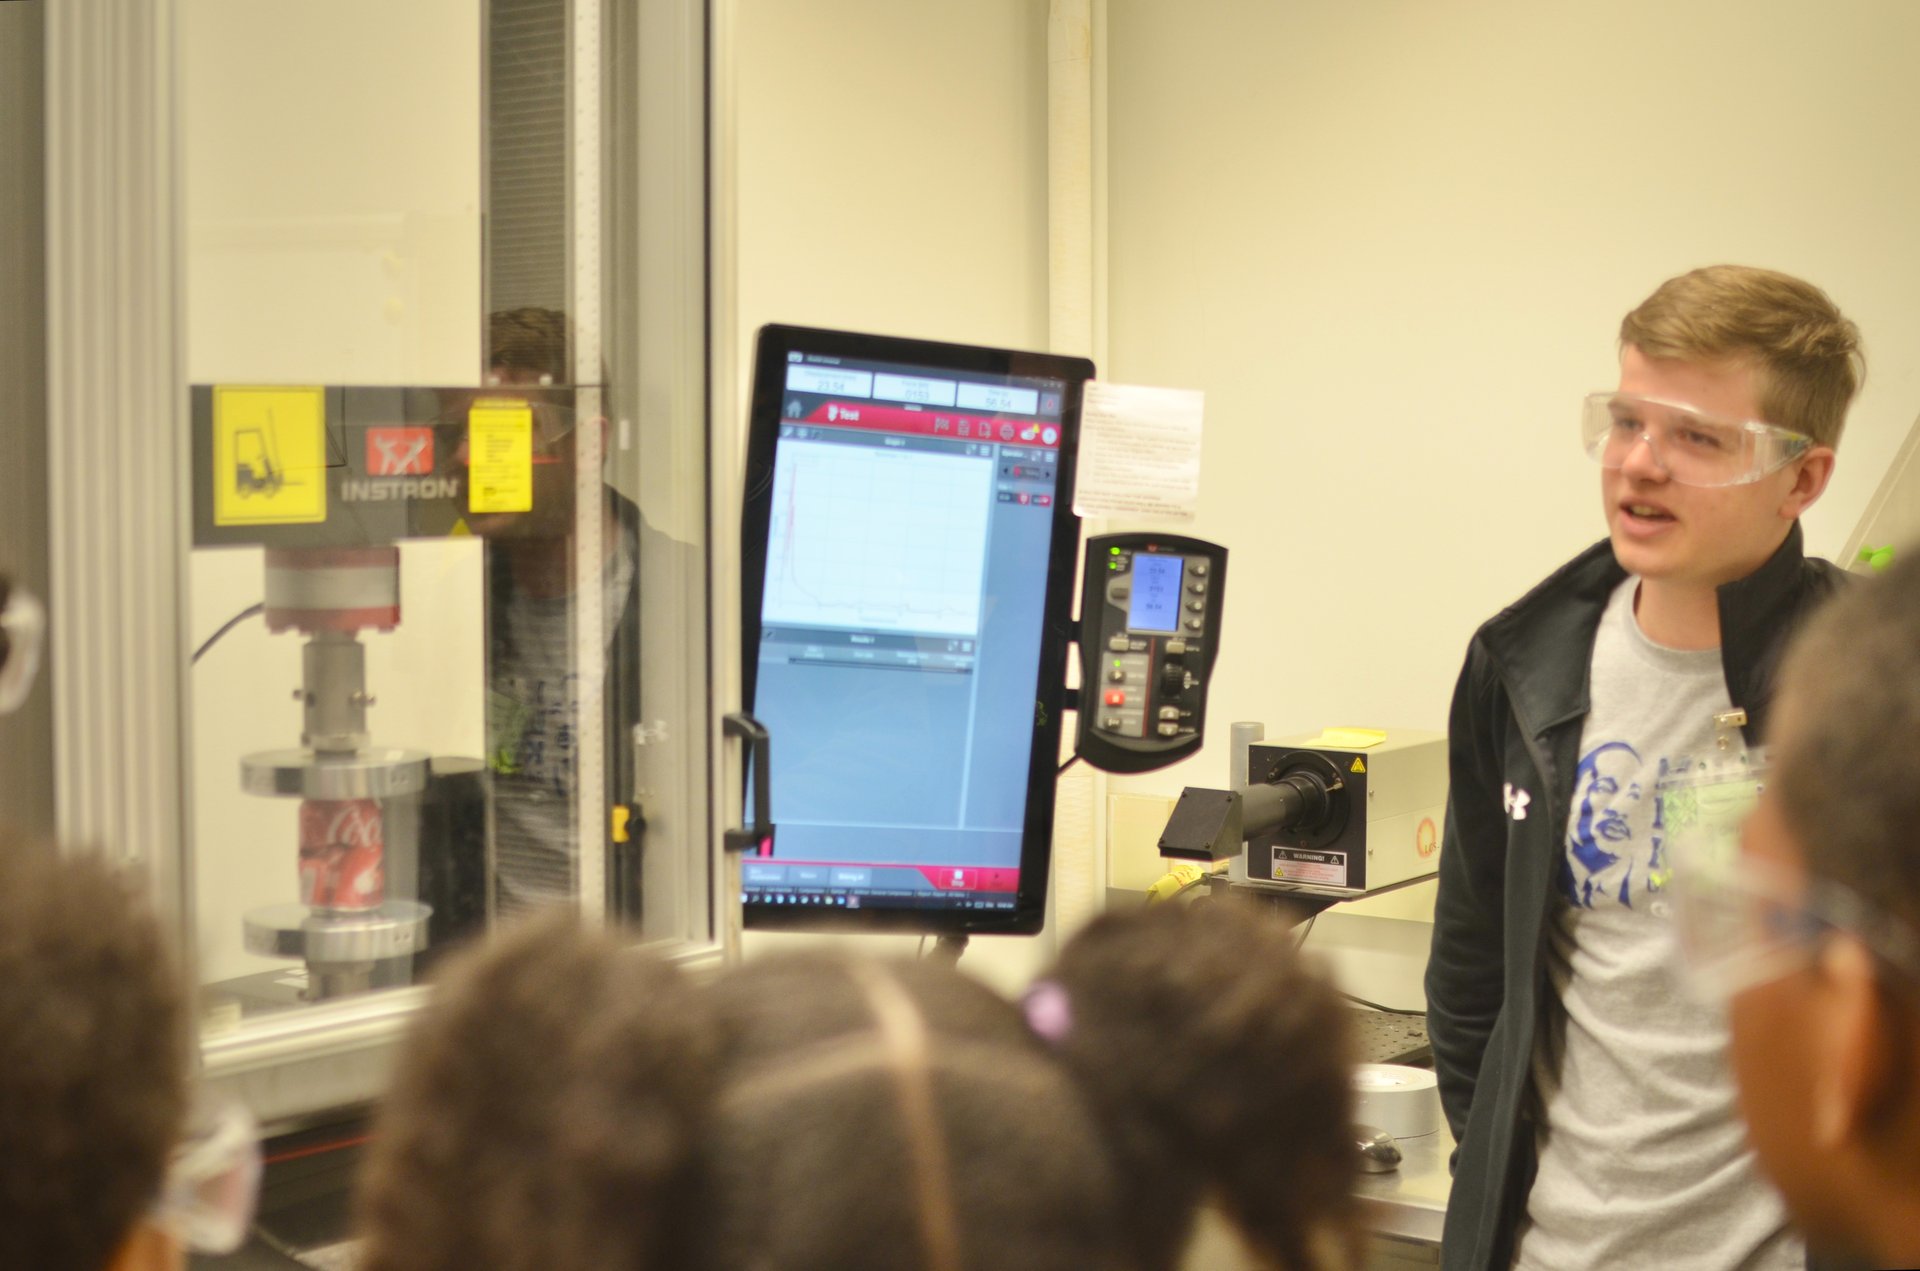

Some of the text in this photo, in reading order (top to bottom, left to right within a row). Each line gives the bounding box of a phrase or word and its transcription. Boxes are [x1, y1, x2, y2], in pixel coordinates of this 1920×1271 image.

[839, 408, 860, 421] Test
[342, 479, 458, 502] INSTRON
[1293, 852, 1325, 862] WARNING!
